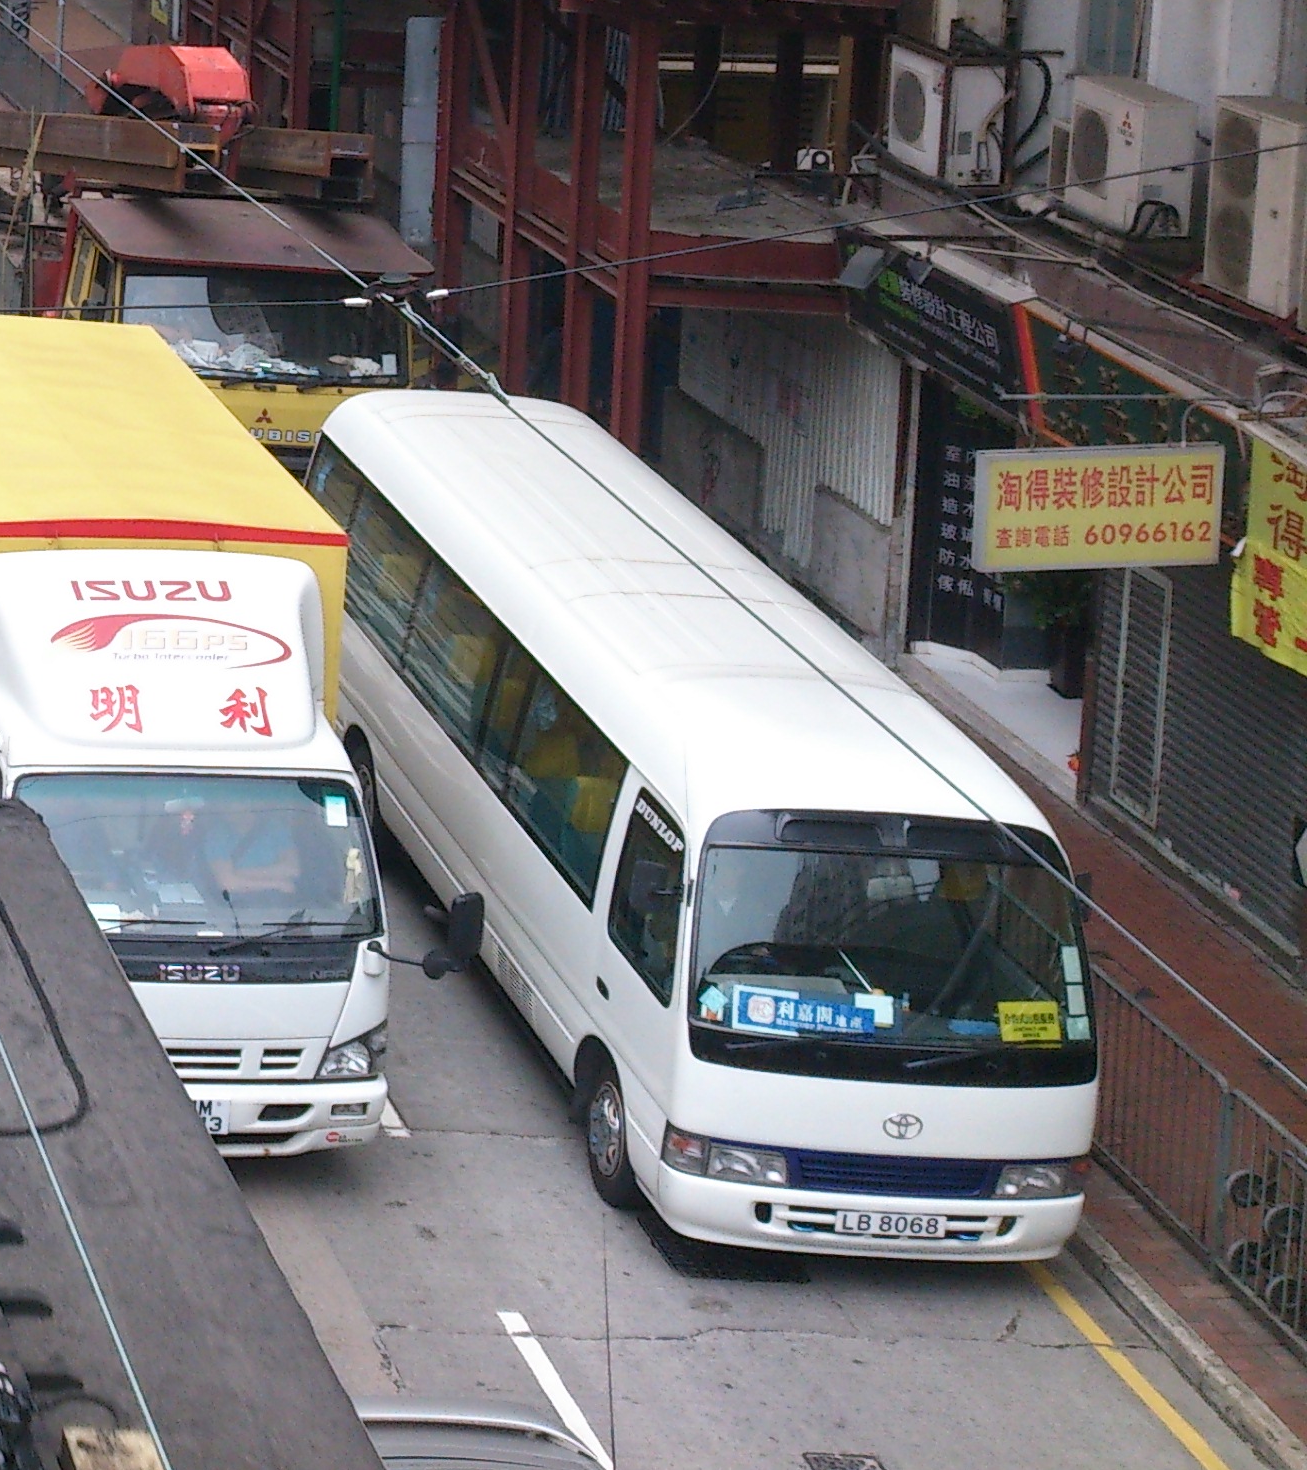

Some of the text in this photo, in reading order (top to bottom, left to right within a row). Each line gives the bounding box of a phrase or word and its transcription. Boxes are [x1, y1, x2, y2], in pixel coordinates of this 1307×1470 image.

[995, 462, 1215, 513] 淘得裝修設計公司
[995, 520, 1213, 550] 查詢電話 60966162
[70, 579, 233, 603] ISUZU
[635, 797, 685, 852] DUNLOP
[159, 963, 241, 982] ISUZU
[841, 1212, 940, 1236] LB 8068
